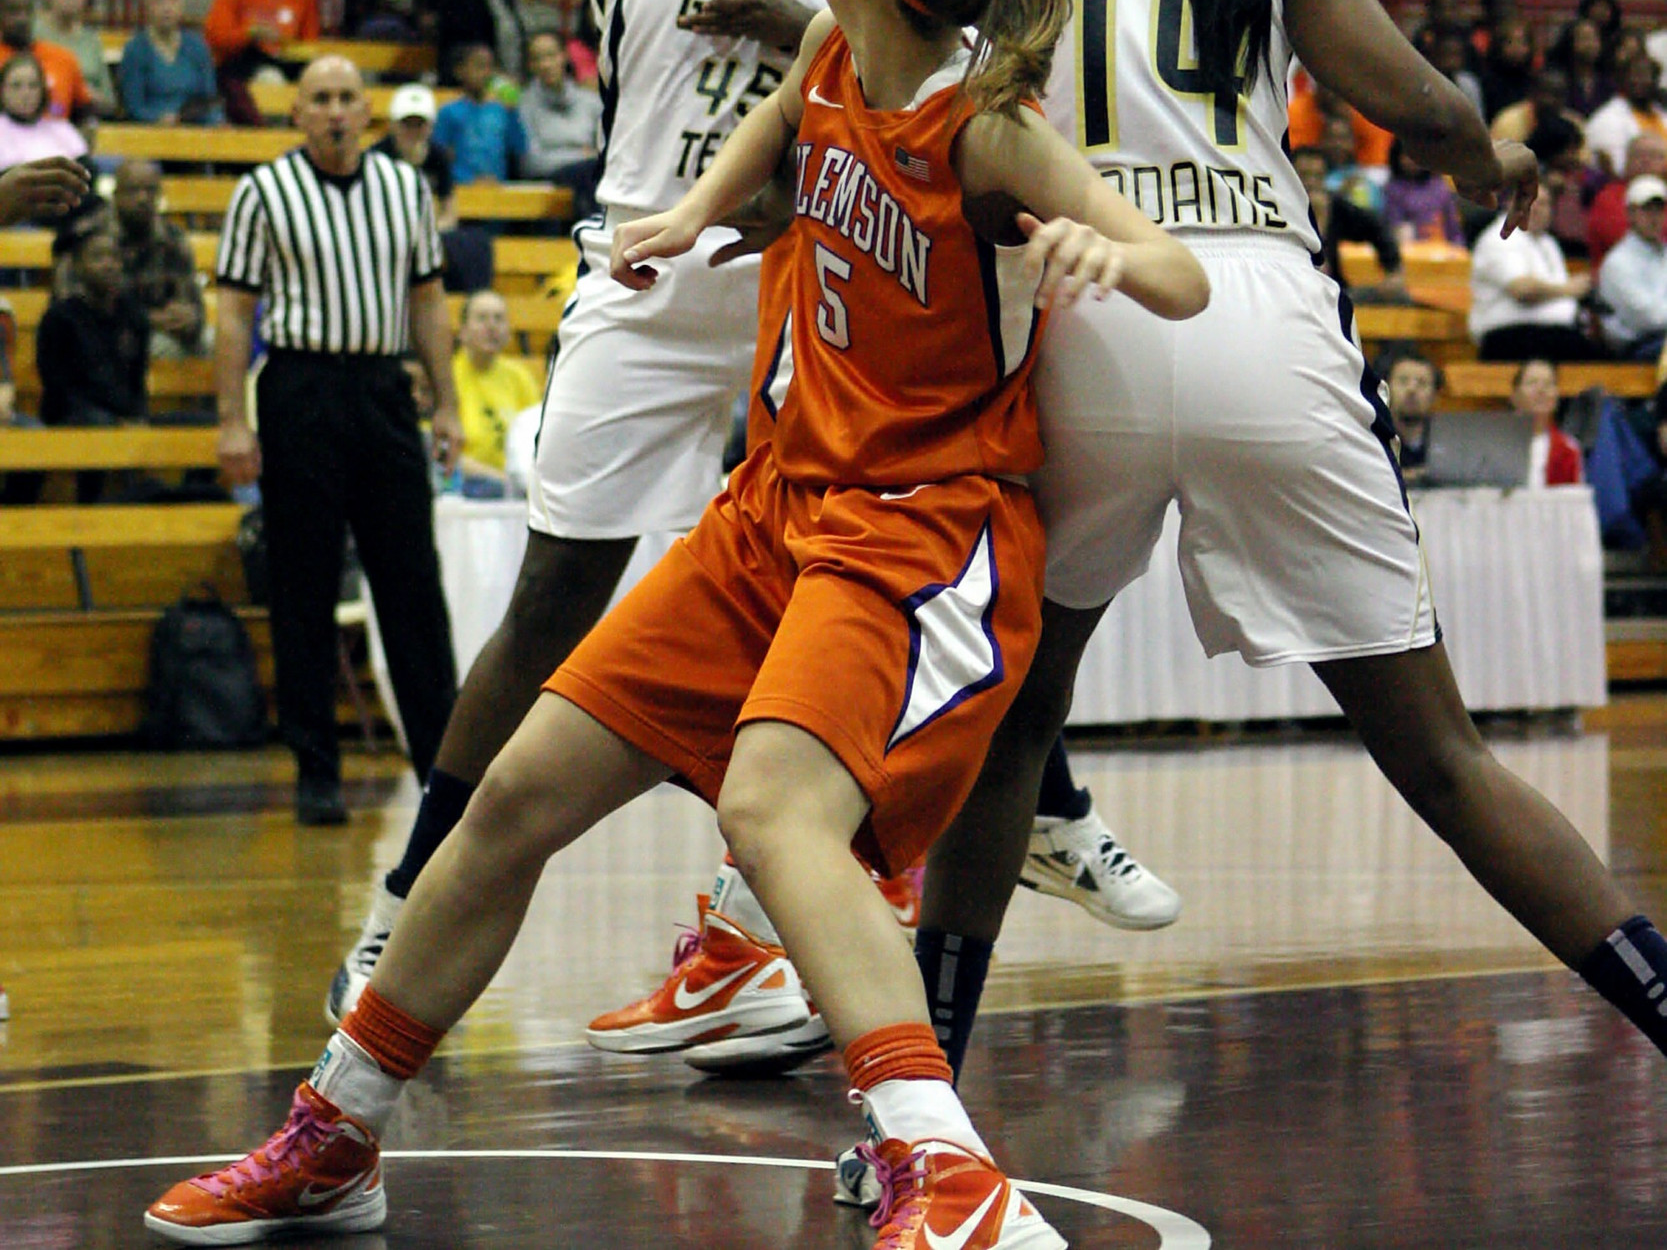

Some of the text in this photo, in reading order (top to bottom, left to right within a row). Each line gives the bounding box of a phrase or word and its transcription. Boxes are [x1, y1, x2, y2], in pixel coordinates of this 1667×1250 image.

[676, 130, 731, 179] TE
[796, 141, 932, 309] LEMSON
[815, 240, 853, 350] 5
